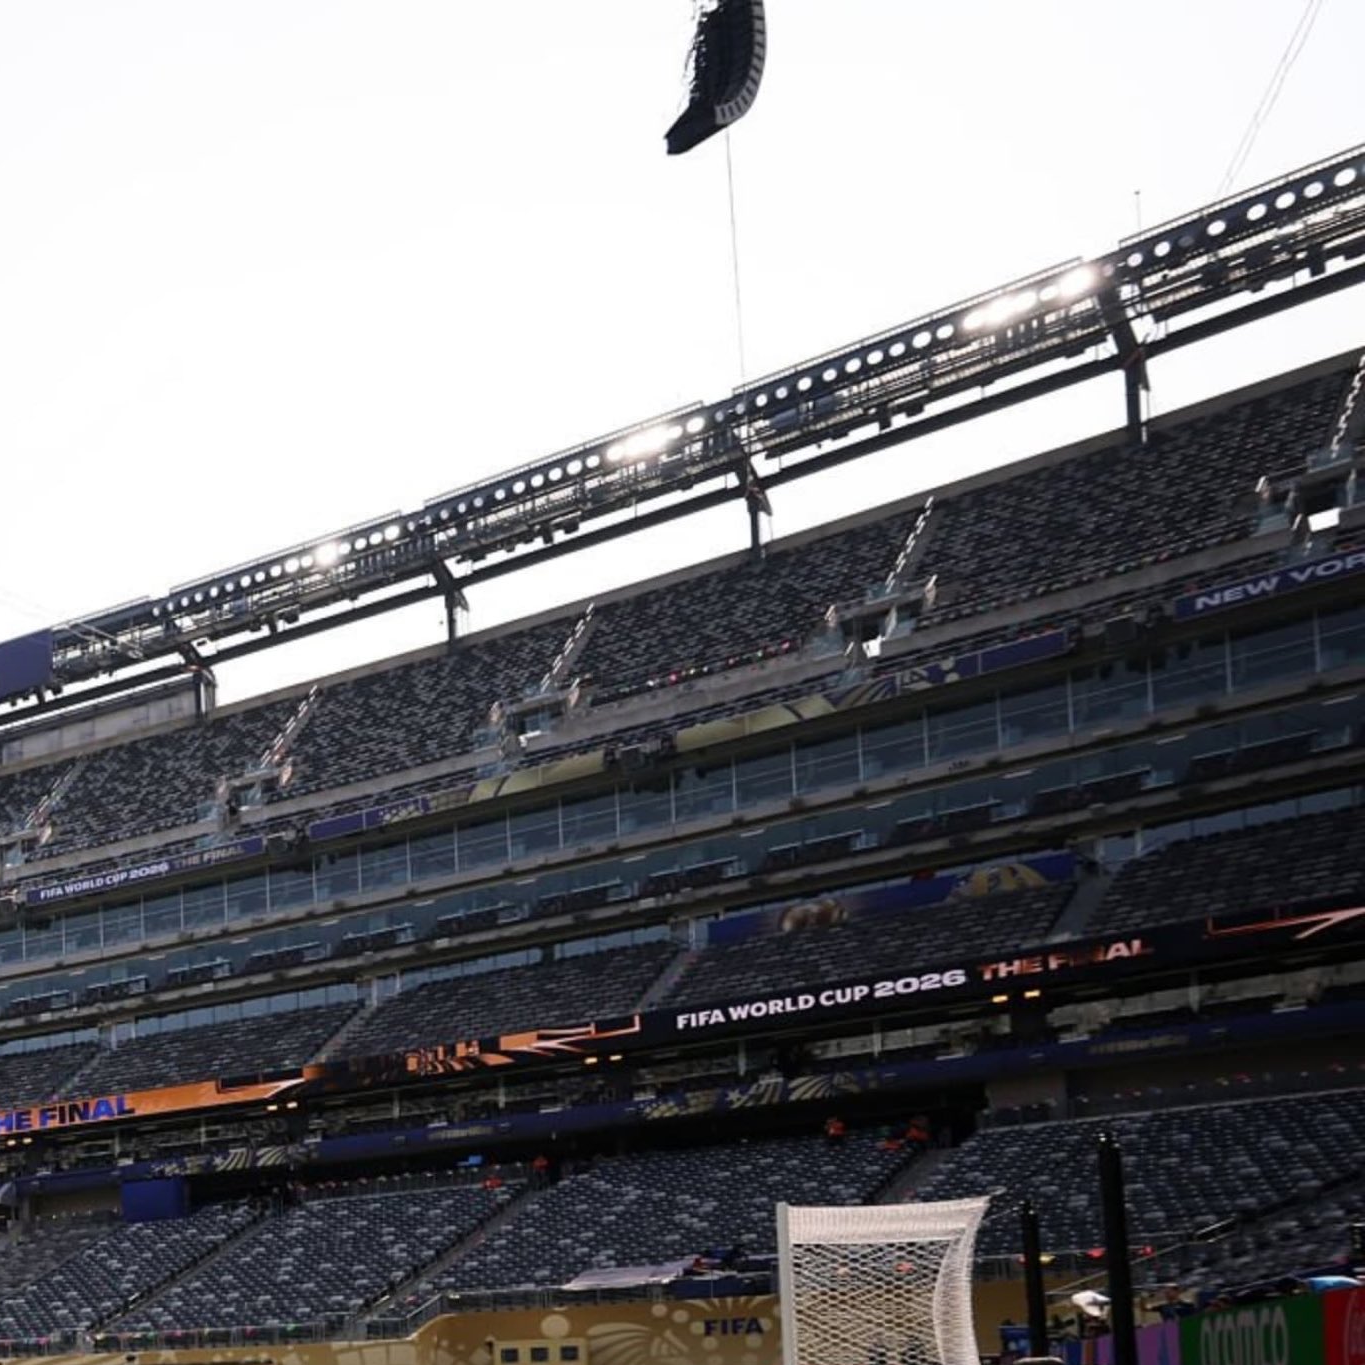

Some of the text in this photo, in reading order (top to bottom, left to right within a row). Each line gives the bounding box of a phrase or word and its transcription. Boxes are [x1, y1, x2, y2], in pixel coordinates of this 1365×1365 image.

[1195, 553, 1365, 610] NEW YOR
[40, 888, 63, 900] FIFA
[64, 878, 104, 895] WORLD
[105, 872, 128, 885] CUP
[129, 863, 169, 880] 2026
[676, 938, 1153, 1031] FIFA WORLD CUP 2026 THE FNAL
[39, 1095, 136, 1126] FINAL
[704, 1318, 764, 1336] FIFA
